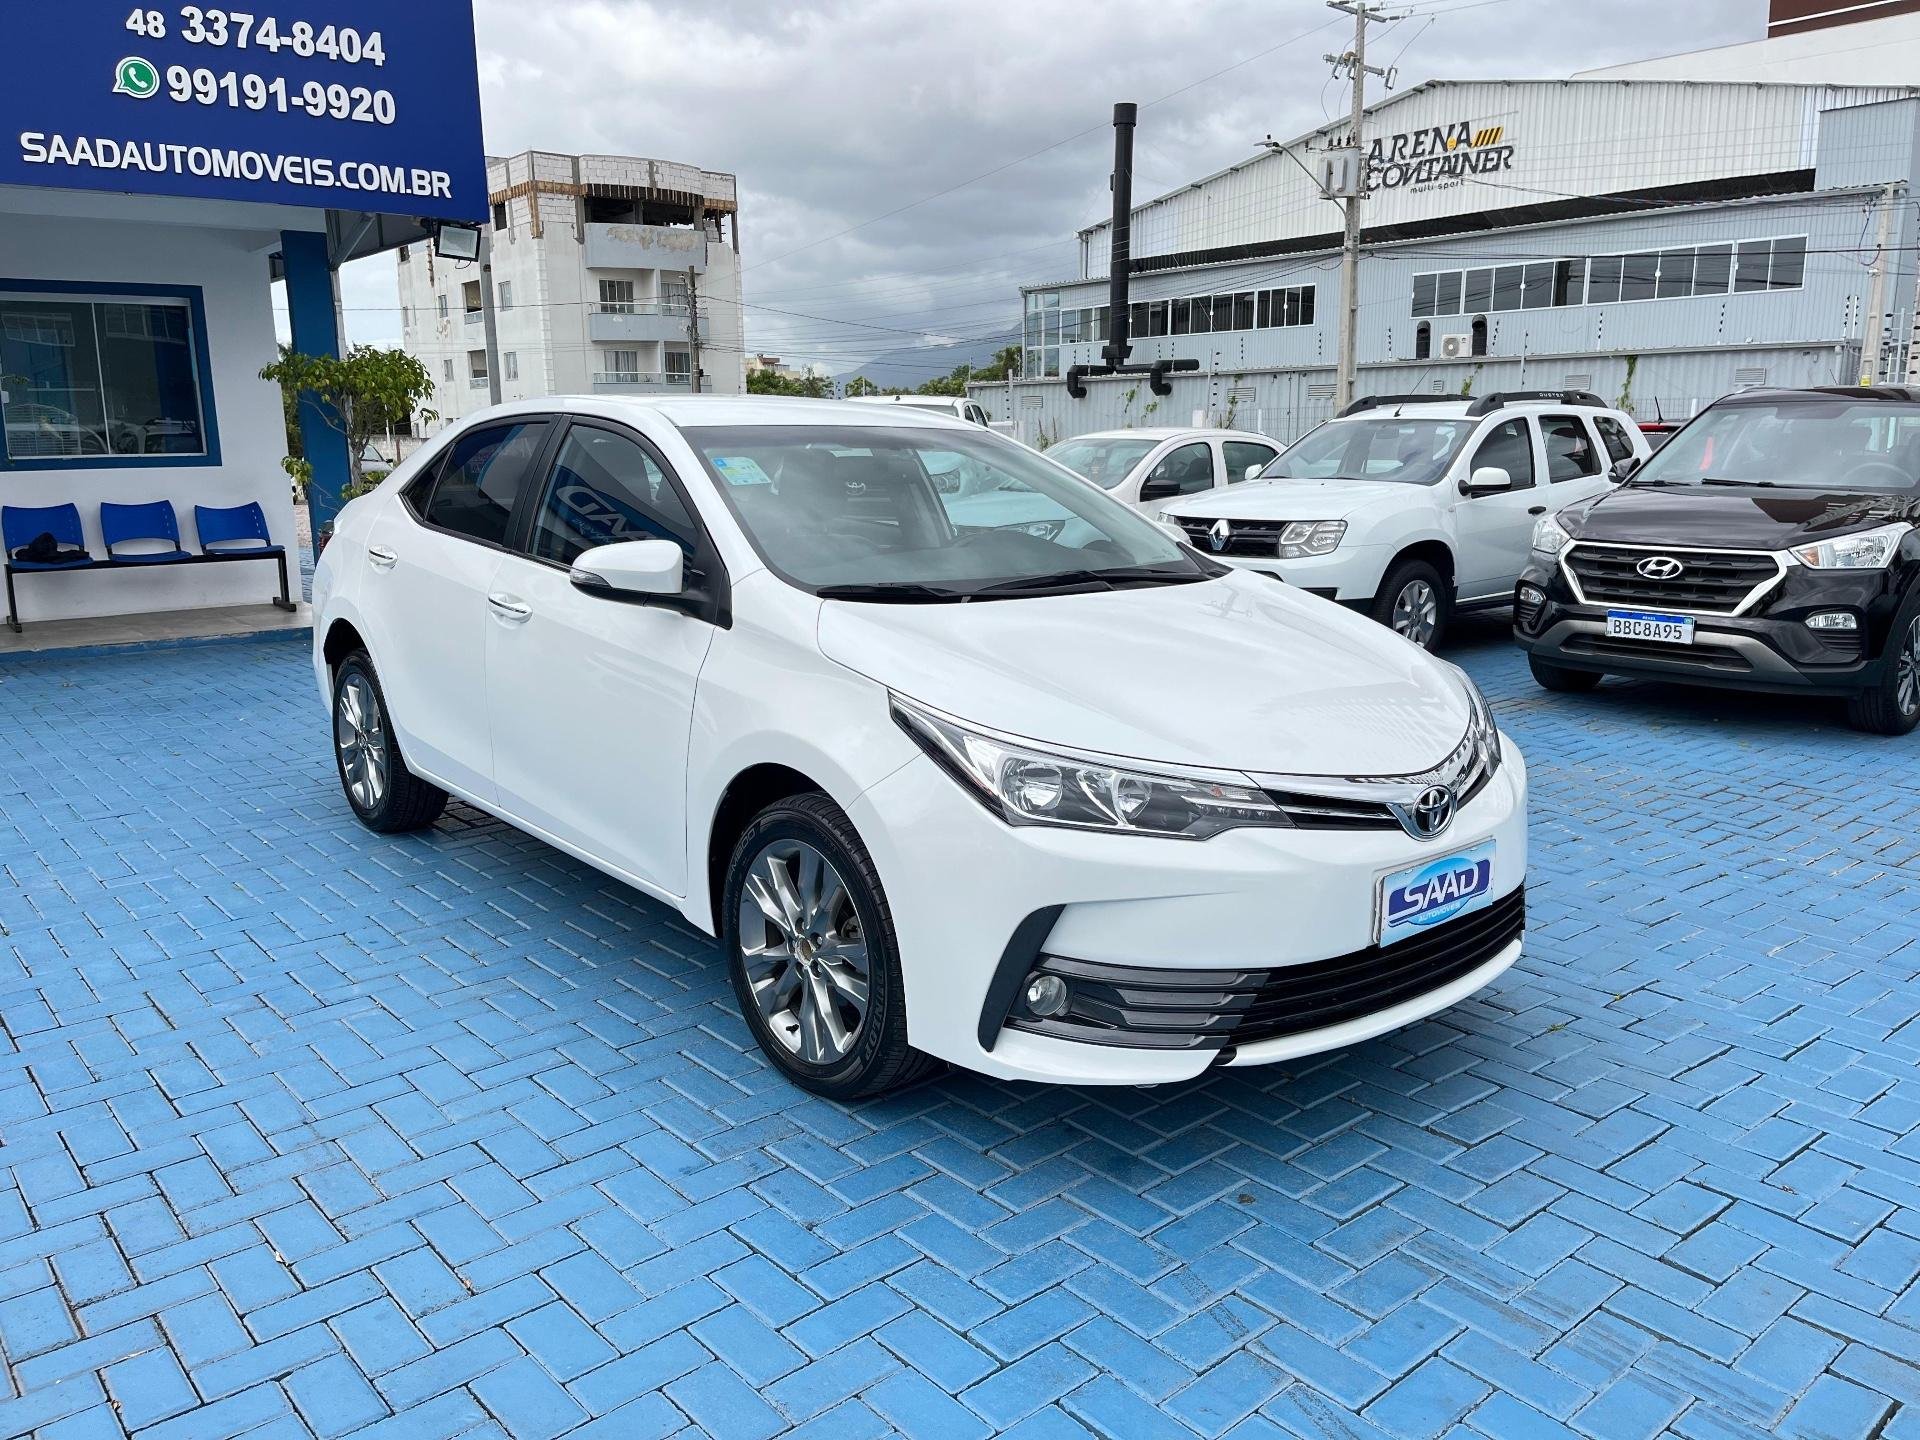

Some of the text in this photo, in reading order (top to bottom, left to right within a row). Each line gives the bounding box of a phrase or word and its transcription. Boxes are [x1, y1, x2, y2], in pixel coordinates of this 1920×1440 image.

[126, 5, 386, 67] 48 3374-8404
[167, 65, 396, 125] 99191-9920
[19, 131, 453, 199] SAADAUTOMOVEIS.COM.BR
[1367, 145, 1515, 192] CONTAINER
[1368, 121, 1473, 164] ARENA
[1613, 619, 1683, 640] BBC8A95
[1393, 862, 1479, 914] SAAD
